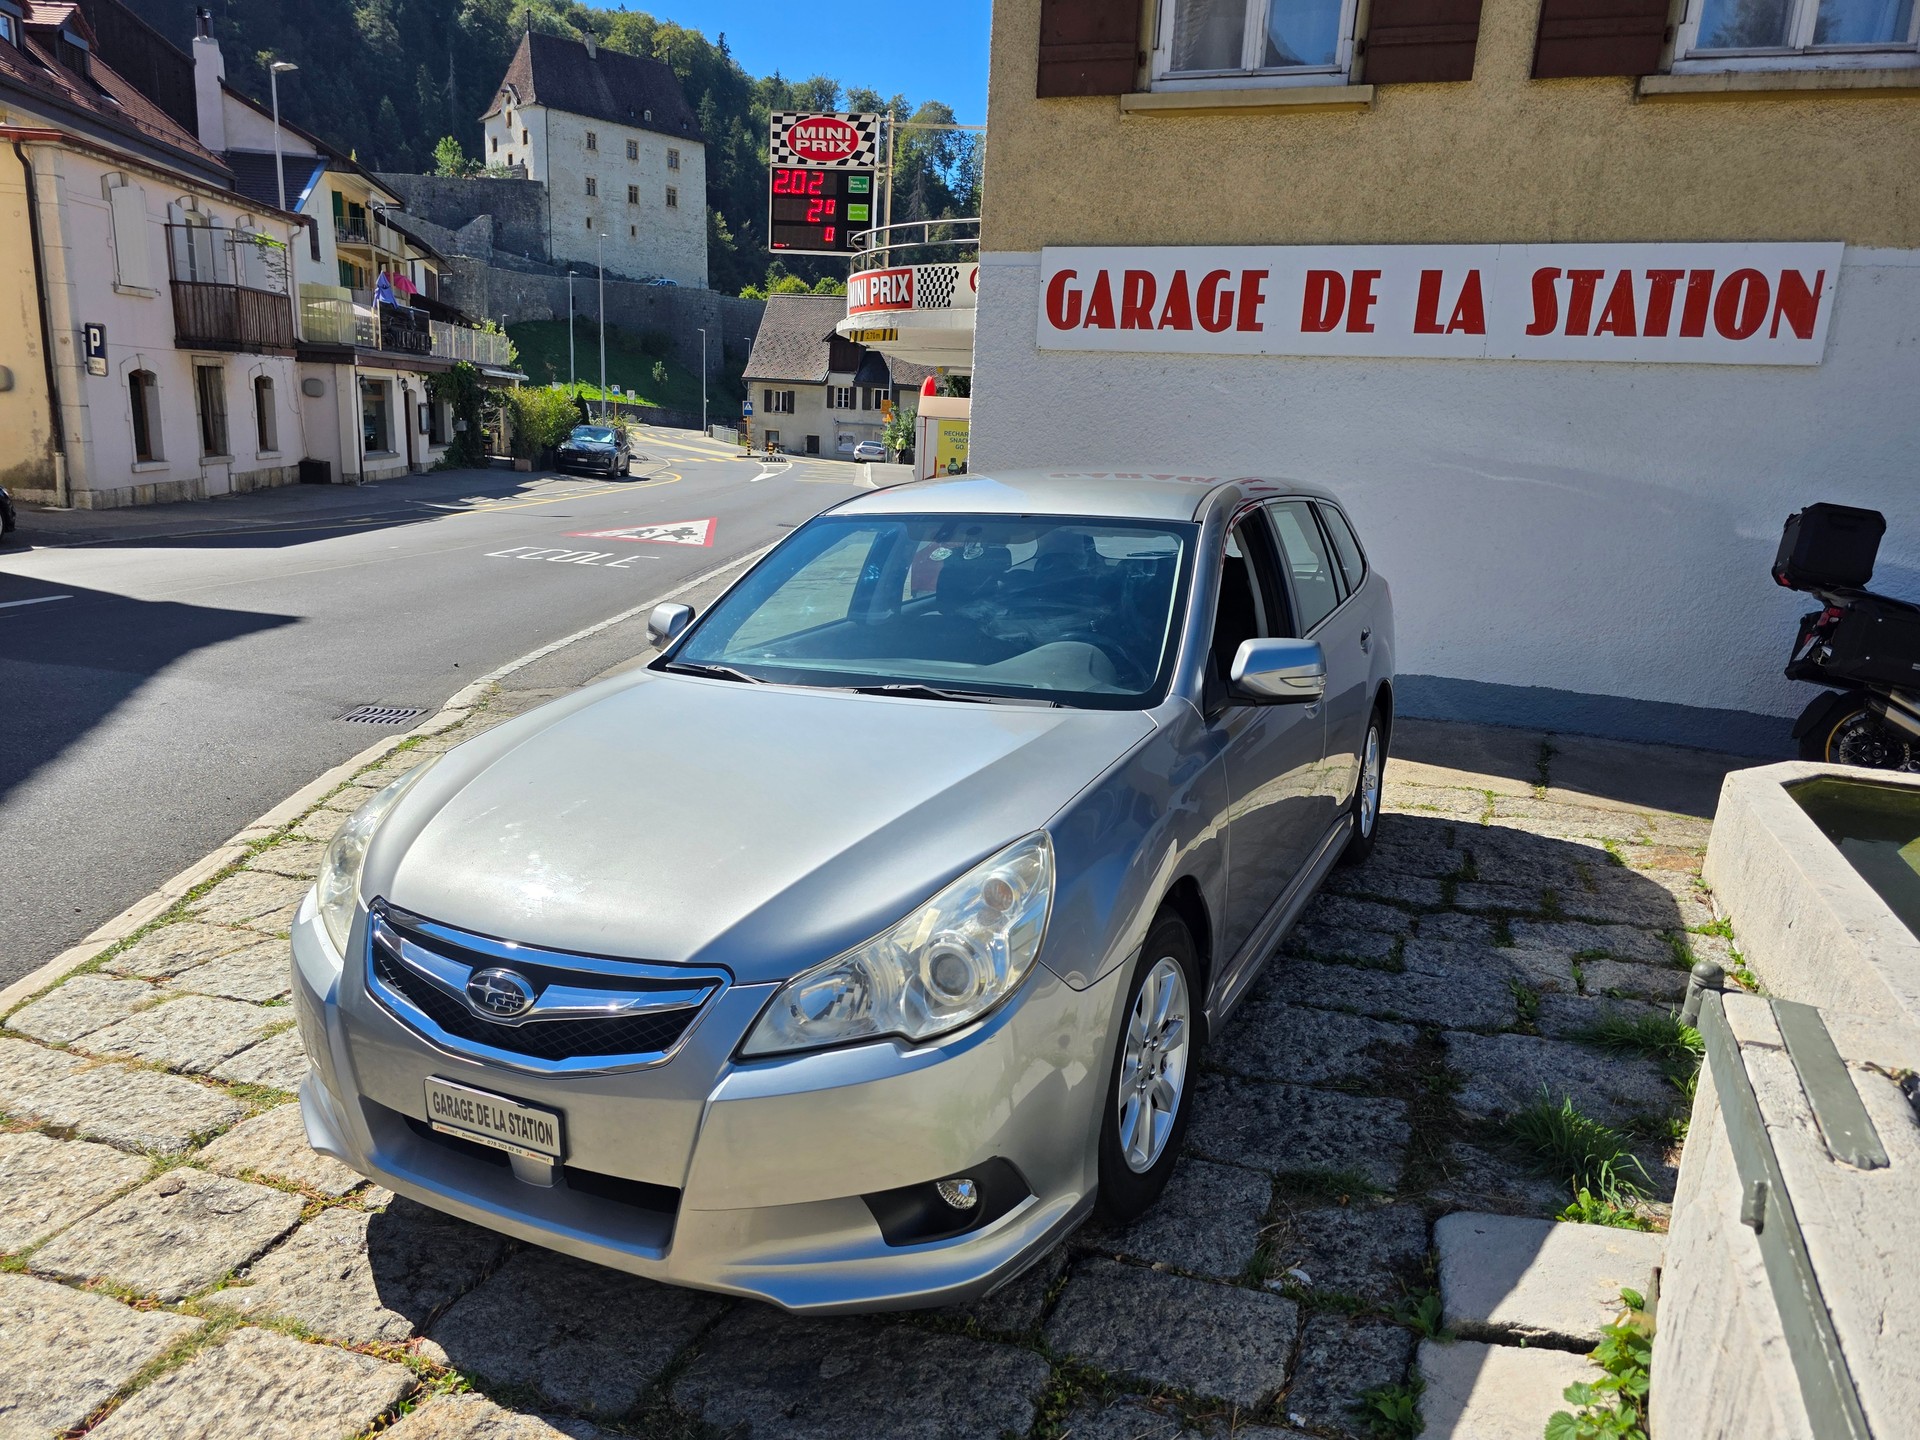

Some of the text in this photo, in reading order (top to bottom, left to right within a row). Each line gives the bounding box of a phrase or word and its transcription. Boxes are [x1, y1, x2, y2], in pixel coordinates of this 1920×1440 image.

[795, 126, 851, 140] MINI
[795, 140, 852, 153] PRIX
[849, 273, 911, 308] MINI PRIX
[1045, 268, 1270, 333] GARAGE
[1300, 269, 1382, 333] DE
[1413, 269, 1487, 335] LA
[1525, 267, 1826, 341] STATION
[89, 328, 101, 355] P
[483, 546, 660, 568] ECOLE
[432, 1091, 554, 1147] GARAGE DE LA STATION
